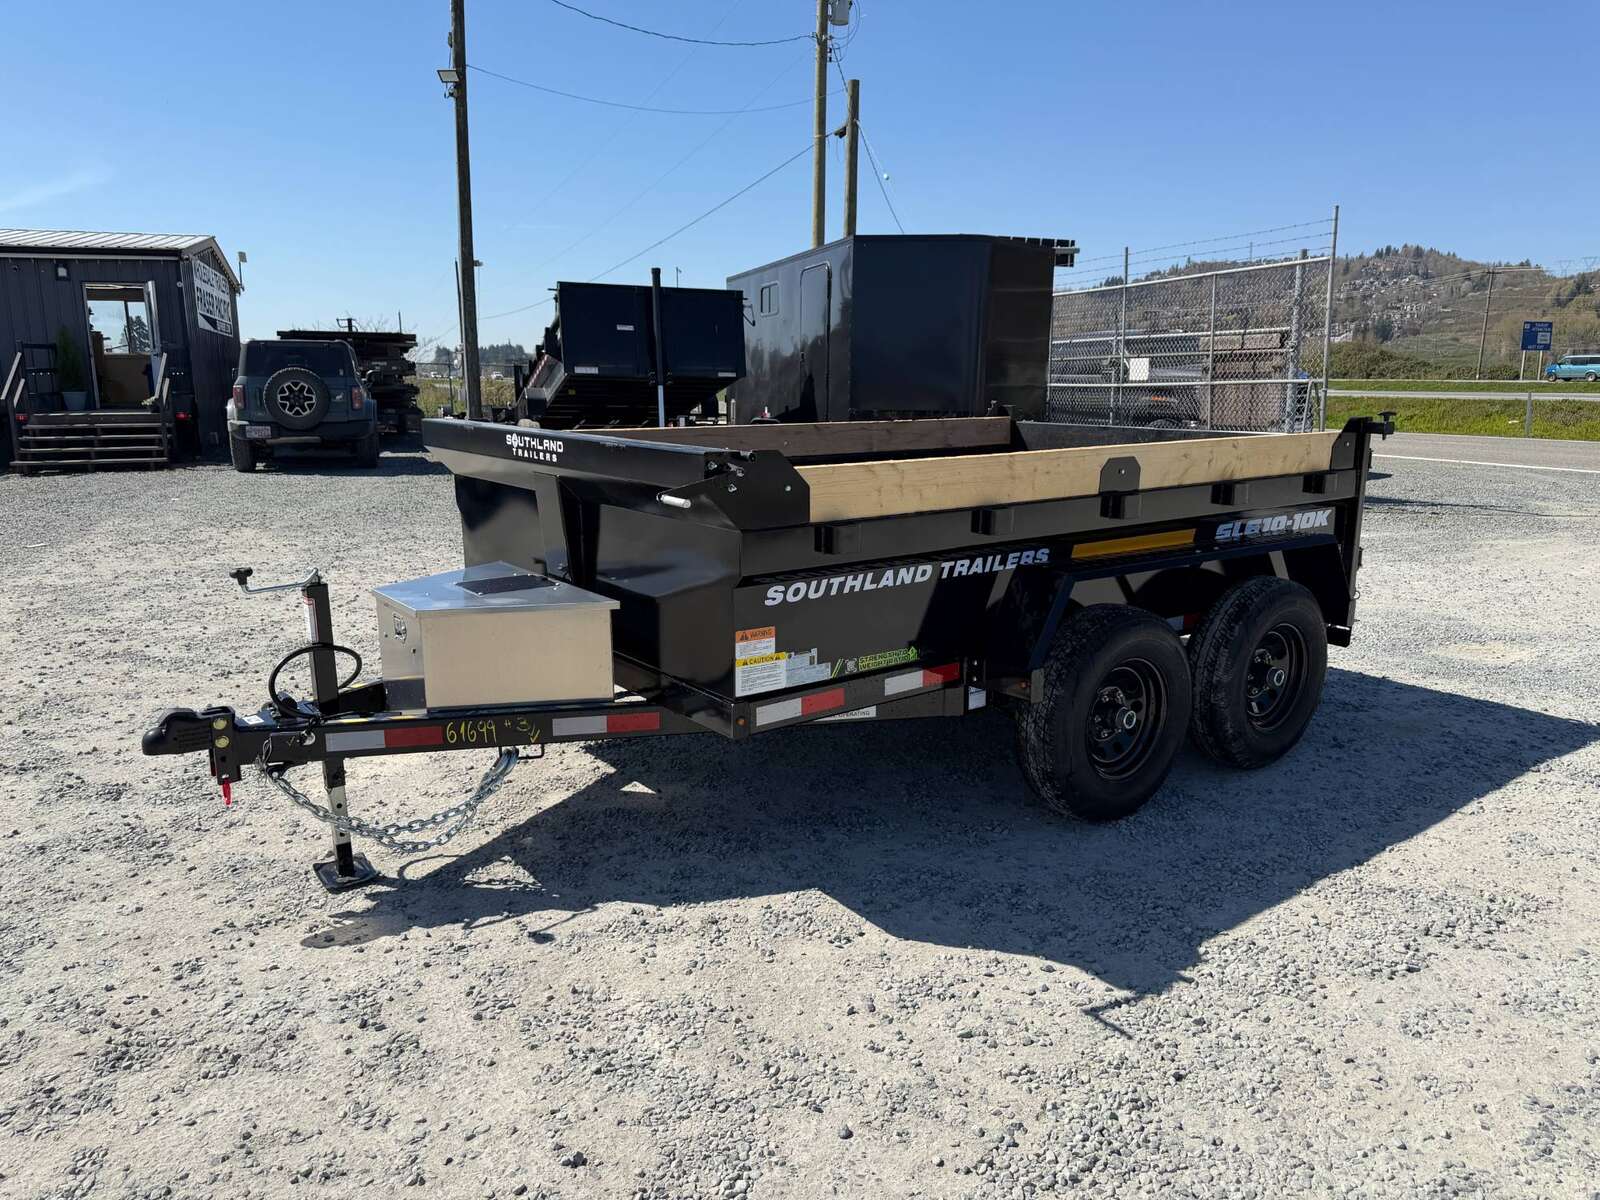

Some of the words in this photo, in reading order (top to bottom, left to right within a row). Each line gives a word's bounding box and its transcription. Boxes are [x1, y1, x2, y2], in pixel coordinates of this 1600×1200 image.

[196, 286, 215, 317] FRASER
[506, 433, 564, 453] SOUTHLAND
[512, 448, 558, 462] TRAILERS
[764, 562, 932, 607] SOUTHLAND
[940, 548, 1050, 579] TRAILERS
[749, 656, 774, 665] CAUTION
